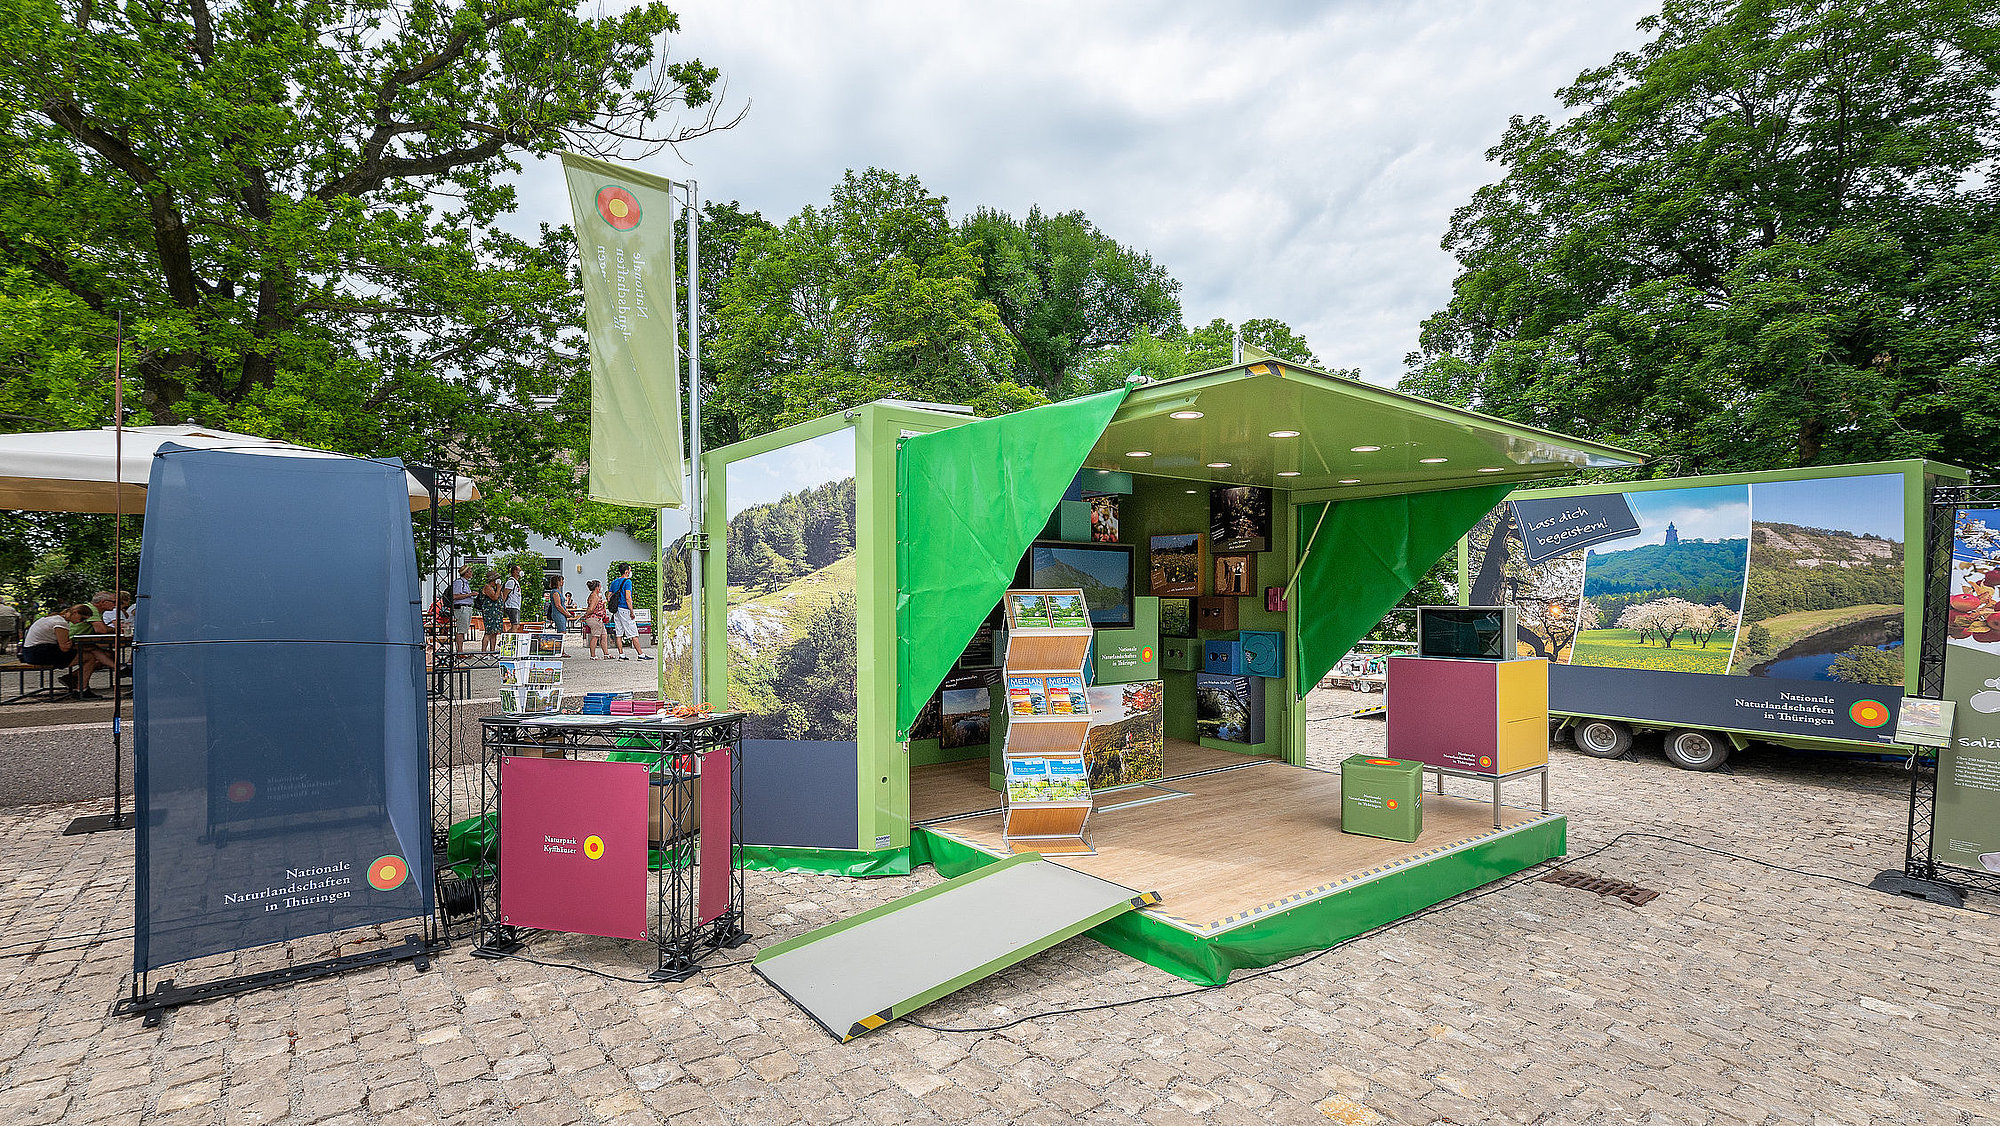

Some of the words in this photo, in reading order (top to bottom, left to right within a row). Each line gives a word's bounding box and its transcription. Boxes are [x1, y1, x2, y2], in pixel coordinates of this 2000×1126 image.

[1528, 517, 1555, 531] Lass
[1559, 506, 1589, 522] dich
[1535, 517, 1609, 545] begeistern!
[1048, 677, 1080, 685] MERIAN
[1734, 698, 1835, 714] Naturlandschaften
[1780, 692, 1835, 704] Nationale
[1763, 711, 1775, 720] in
[1777, 712, 1835, 726] Thüringen
[544, 835, 577, 845] Naturpark
[543, 844, 577, 854] Kyffhäuser
[285, 860, 351, 880] Nationale
[224, 876, 351, 905] Naturlandschaften
[264, 902, 279, 912] in
[282, 889, 351, 909] Thüringen
